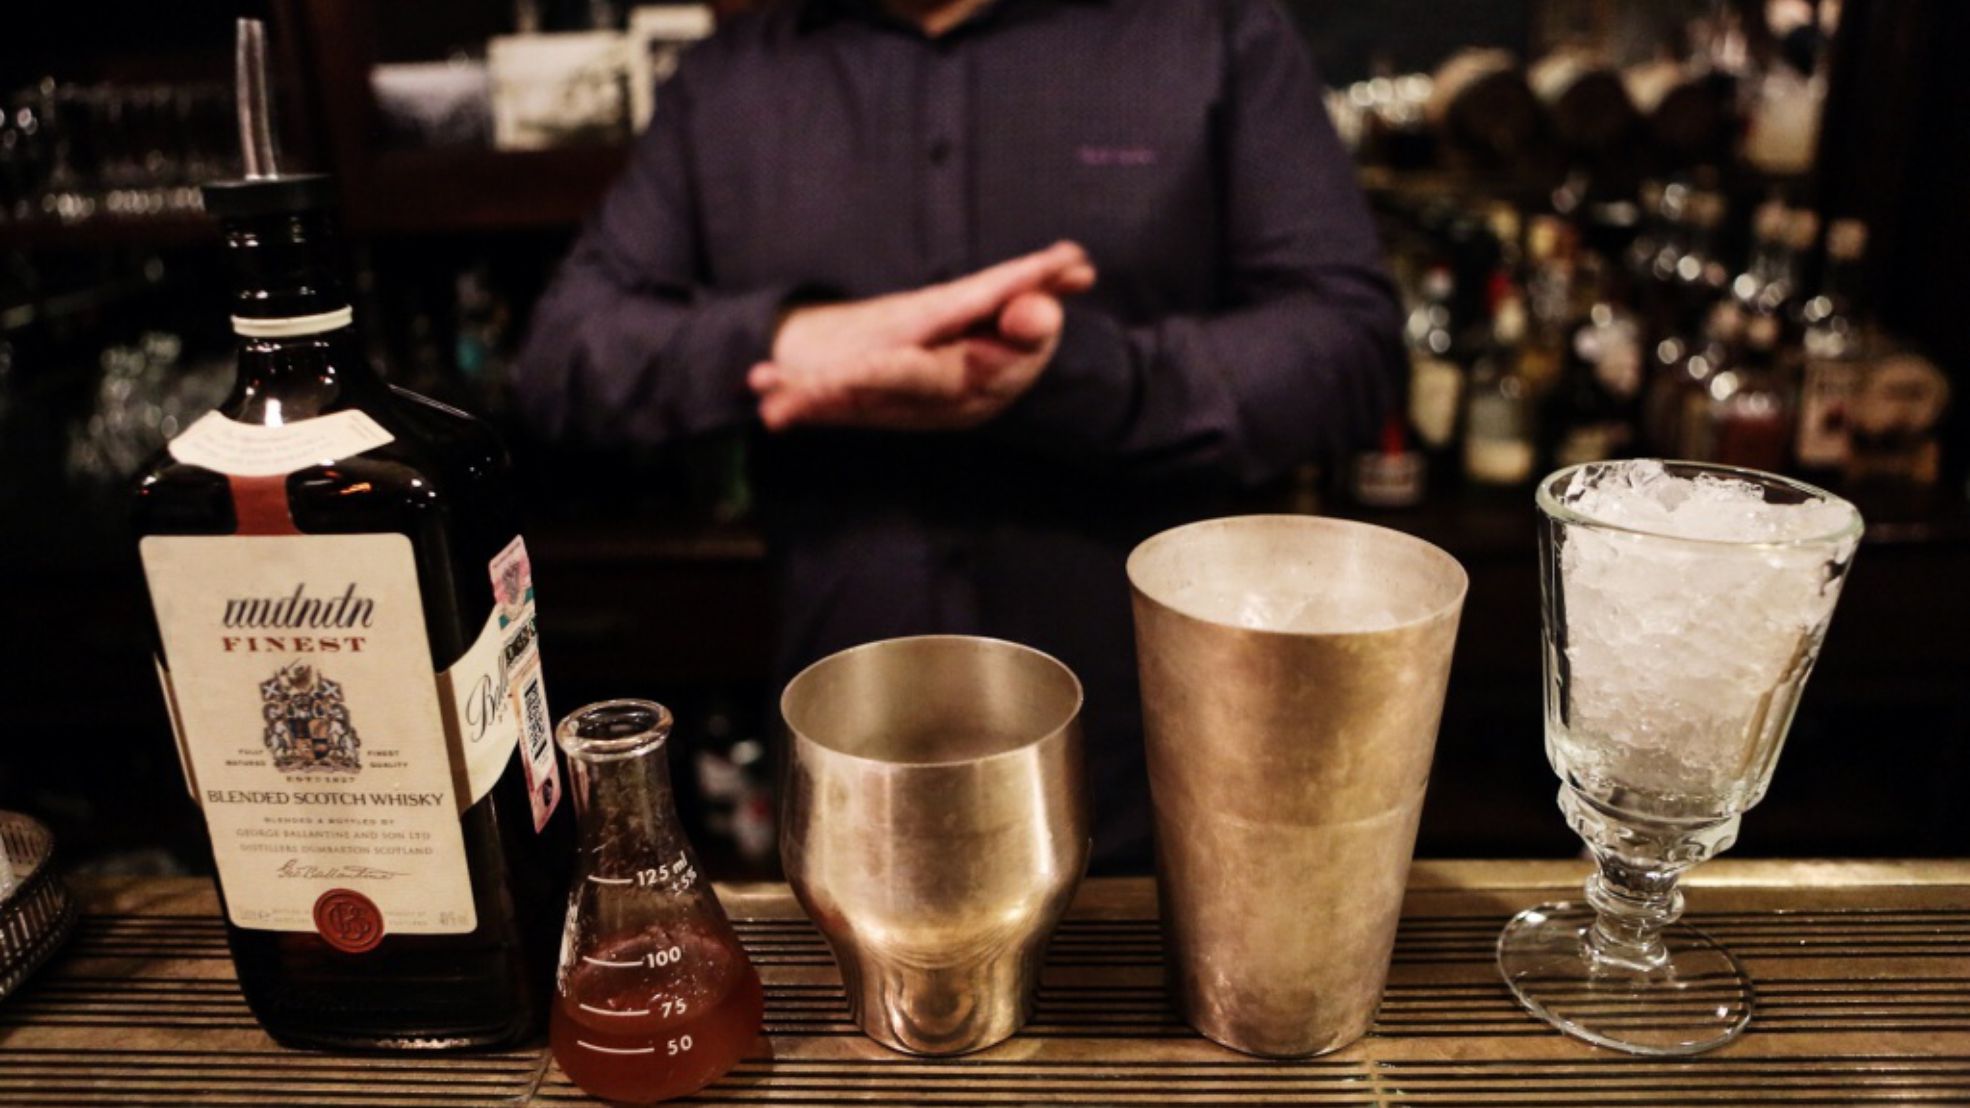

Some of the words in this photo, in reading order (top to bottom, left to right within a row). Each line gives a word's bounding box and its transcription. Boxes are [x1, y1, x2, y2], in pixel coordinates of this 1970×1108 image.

[222, 636, 367, 653] FINEST
[206, 790, 290, 806] BLENDED
[293, 791, 367, 807] SCOTCH
[368, 792, 445, 807] WHISKY
[263, 817, 313, 825] BLENDED
[236, 828, 280, 839] GEORGE
[283, 830, 350, 840] BALLANTINE
[353, 831, 378, 841] AND
[382, 832, 405, 841] SON
[409, 832, 431, 841] LTD
[239, 843, 298, 853] DISTILLERS
[374, 846, 433, 856] SCOTLAND
[636, 864, 670, 887] 125
[672, 850, 688, 874] ml
[646, 946, 682, 969] 100
[660, 998, 687, 1019] 75
[666, 1034, 693, 1056] 50
